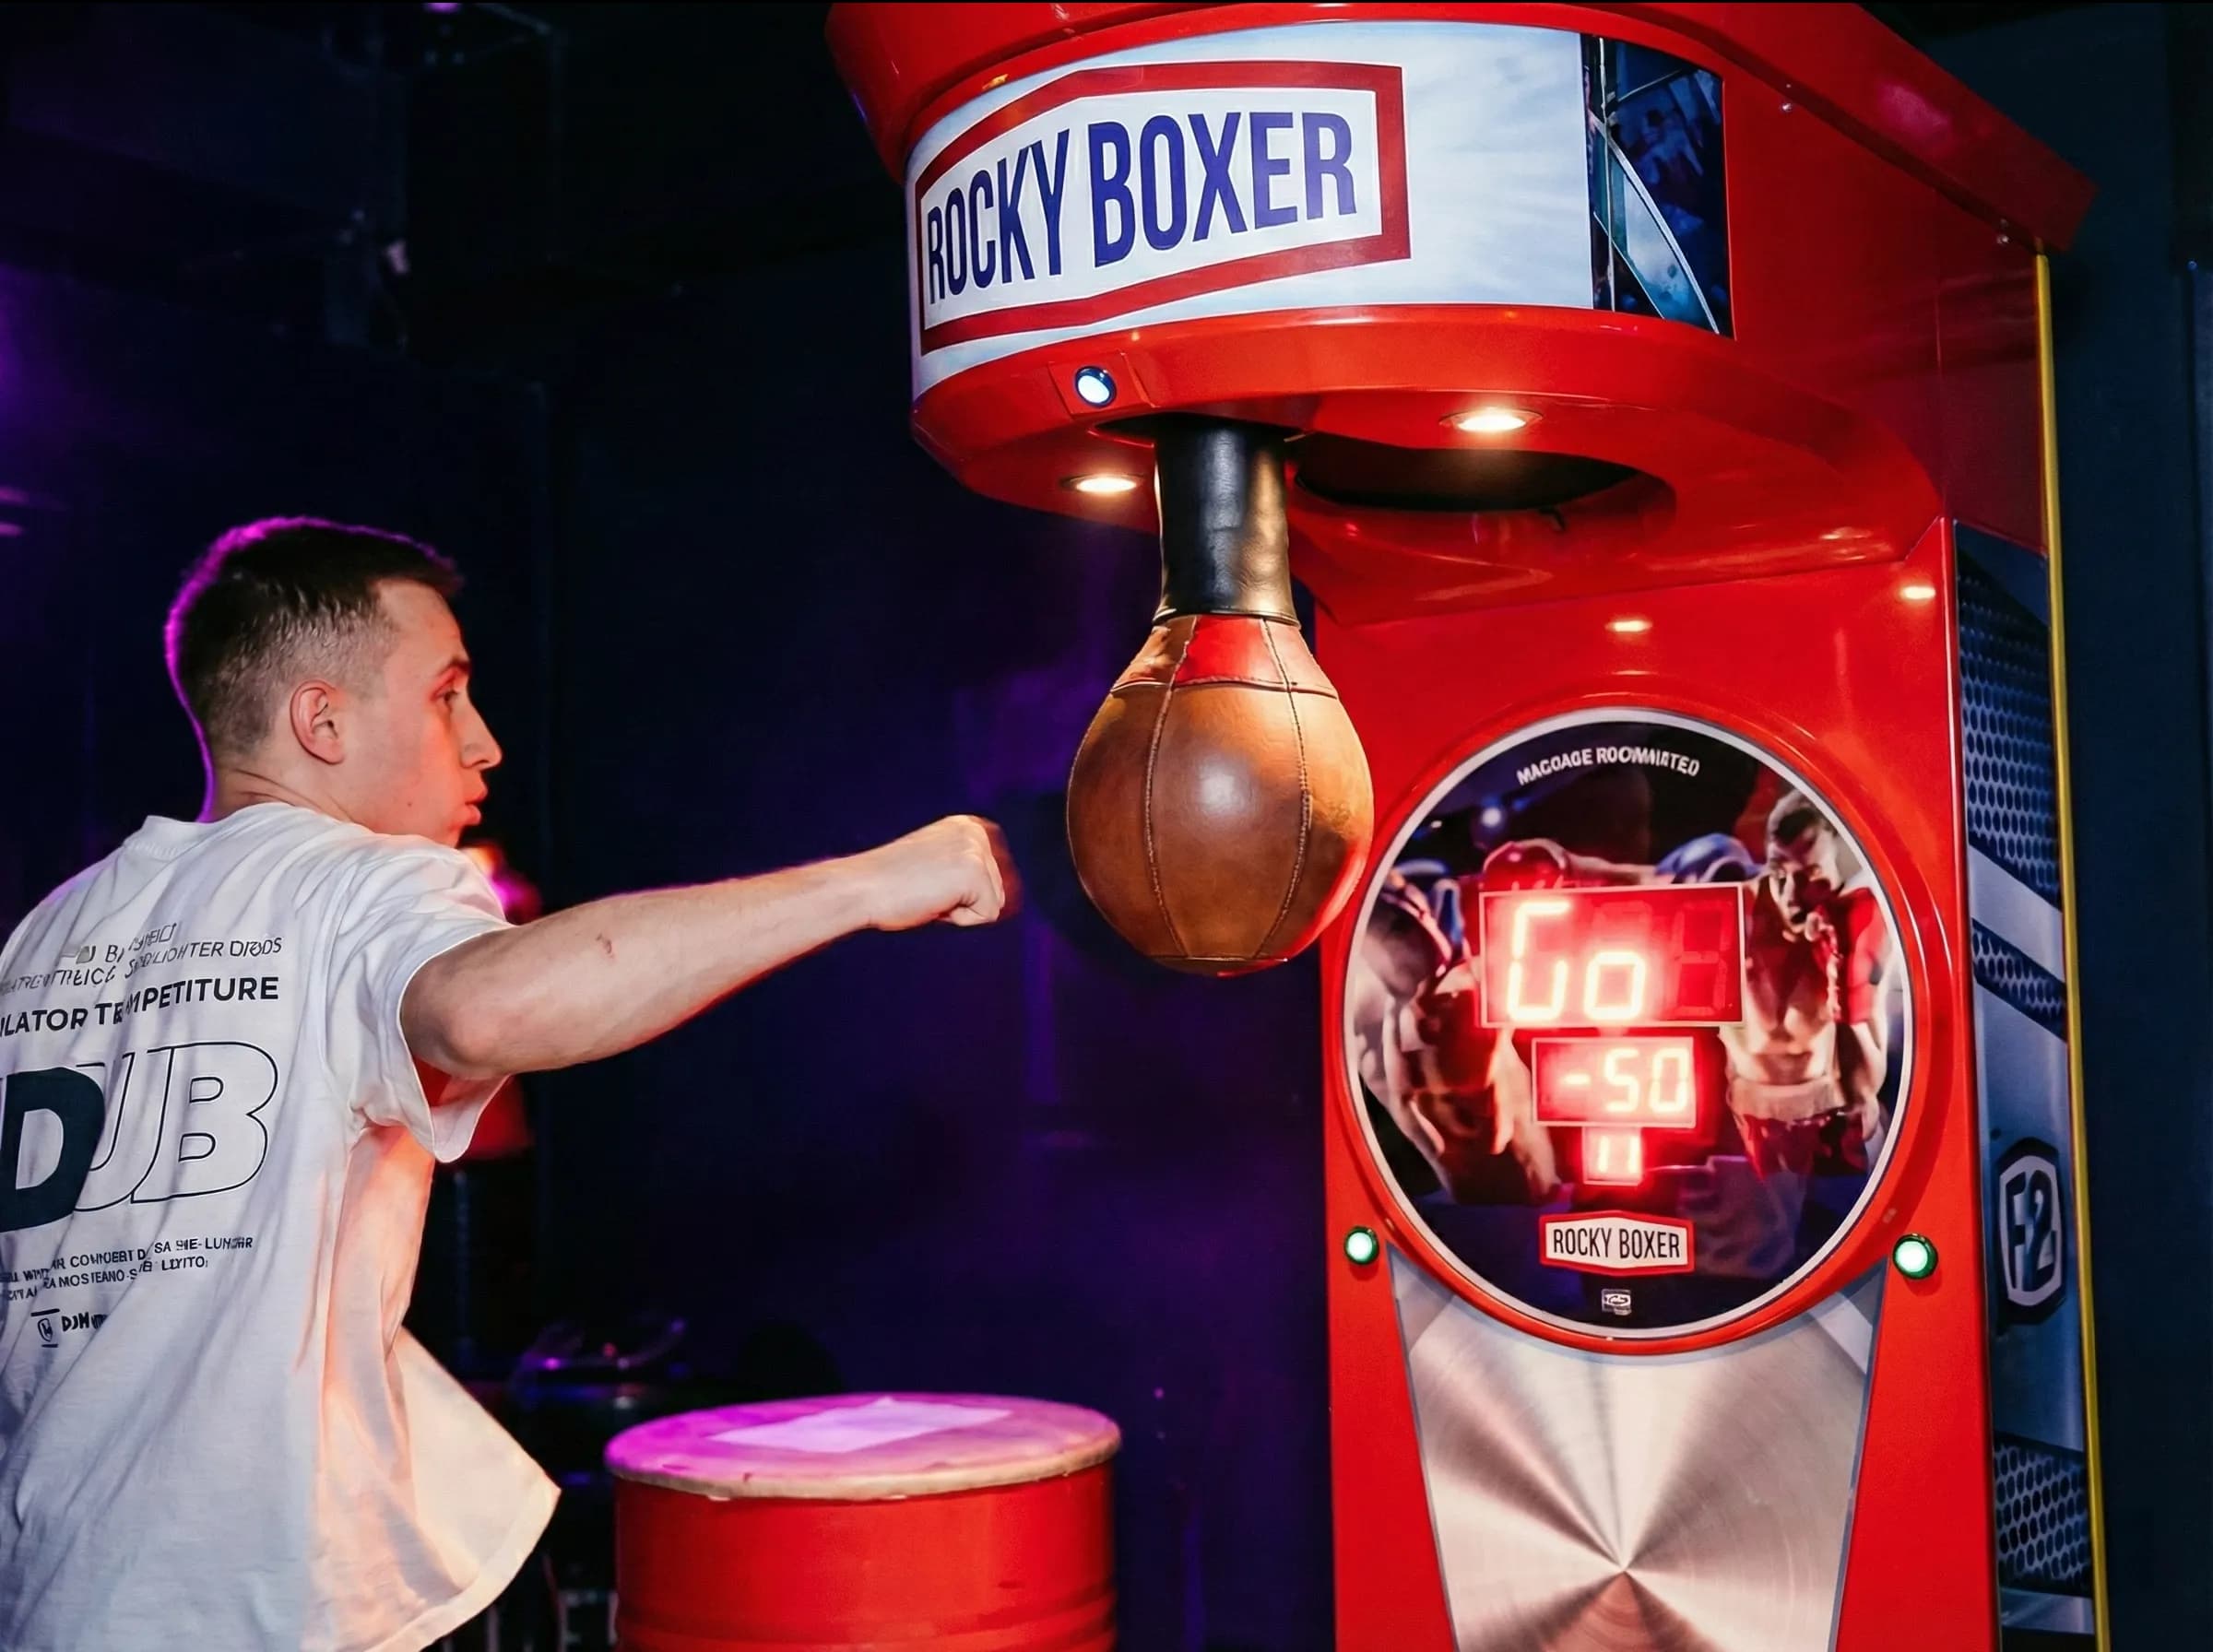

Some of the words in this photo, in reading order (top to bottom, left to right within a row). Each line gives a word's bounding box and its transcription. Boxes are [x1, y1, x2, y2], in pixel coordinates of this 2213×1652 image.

[927, 128, 1071, 305] ROCKY
[1088, 111, 1357, 268] BOXER
[1553, 1227, 1613, 1258] ROCKY
[1619, 1228, 1681, 1259] BOXER
